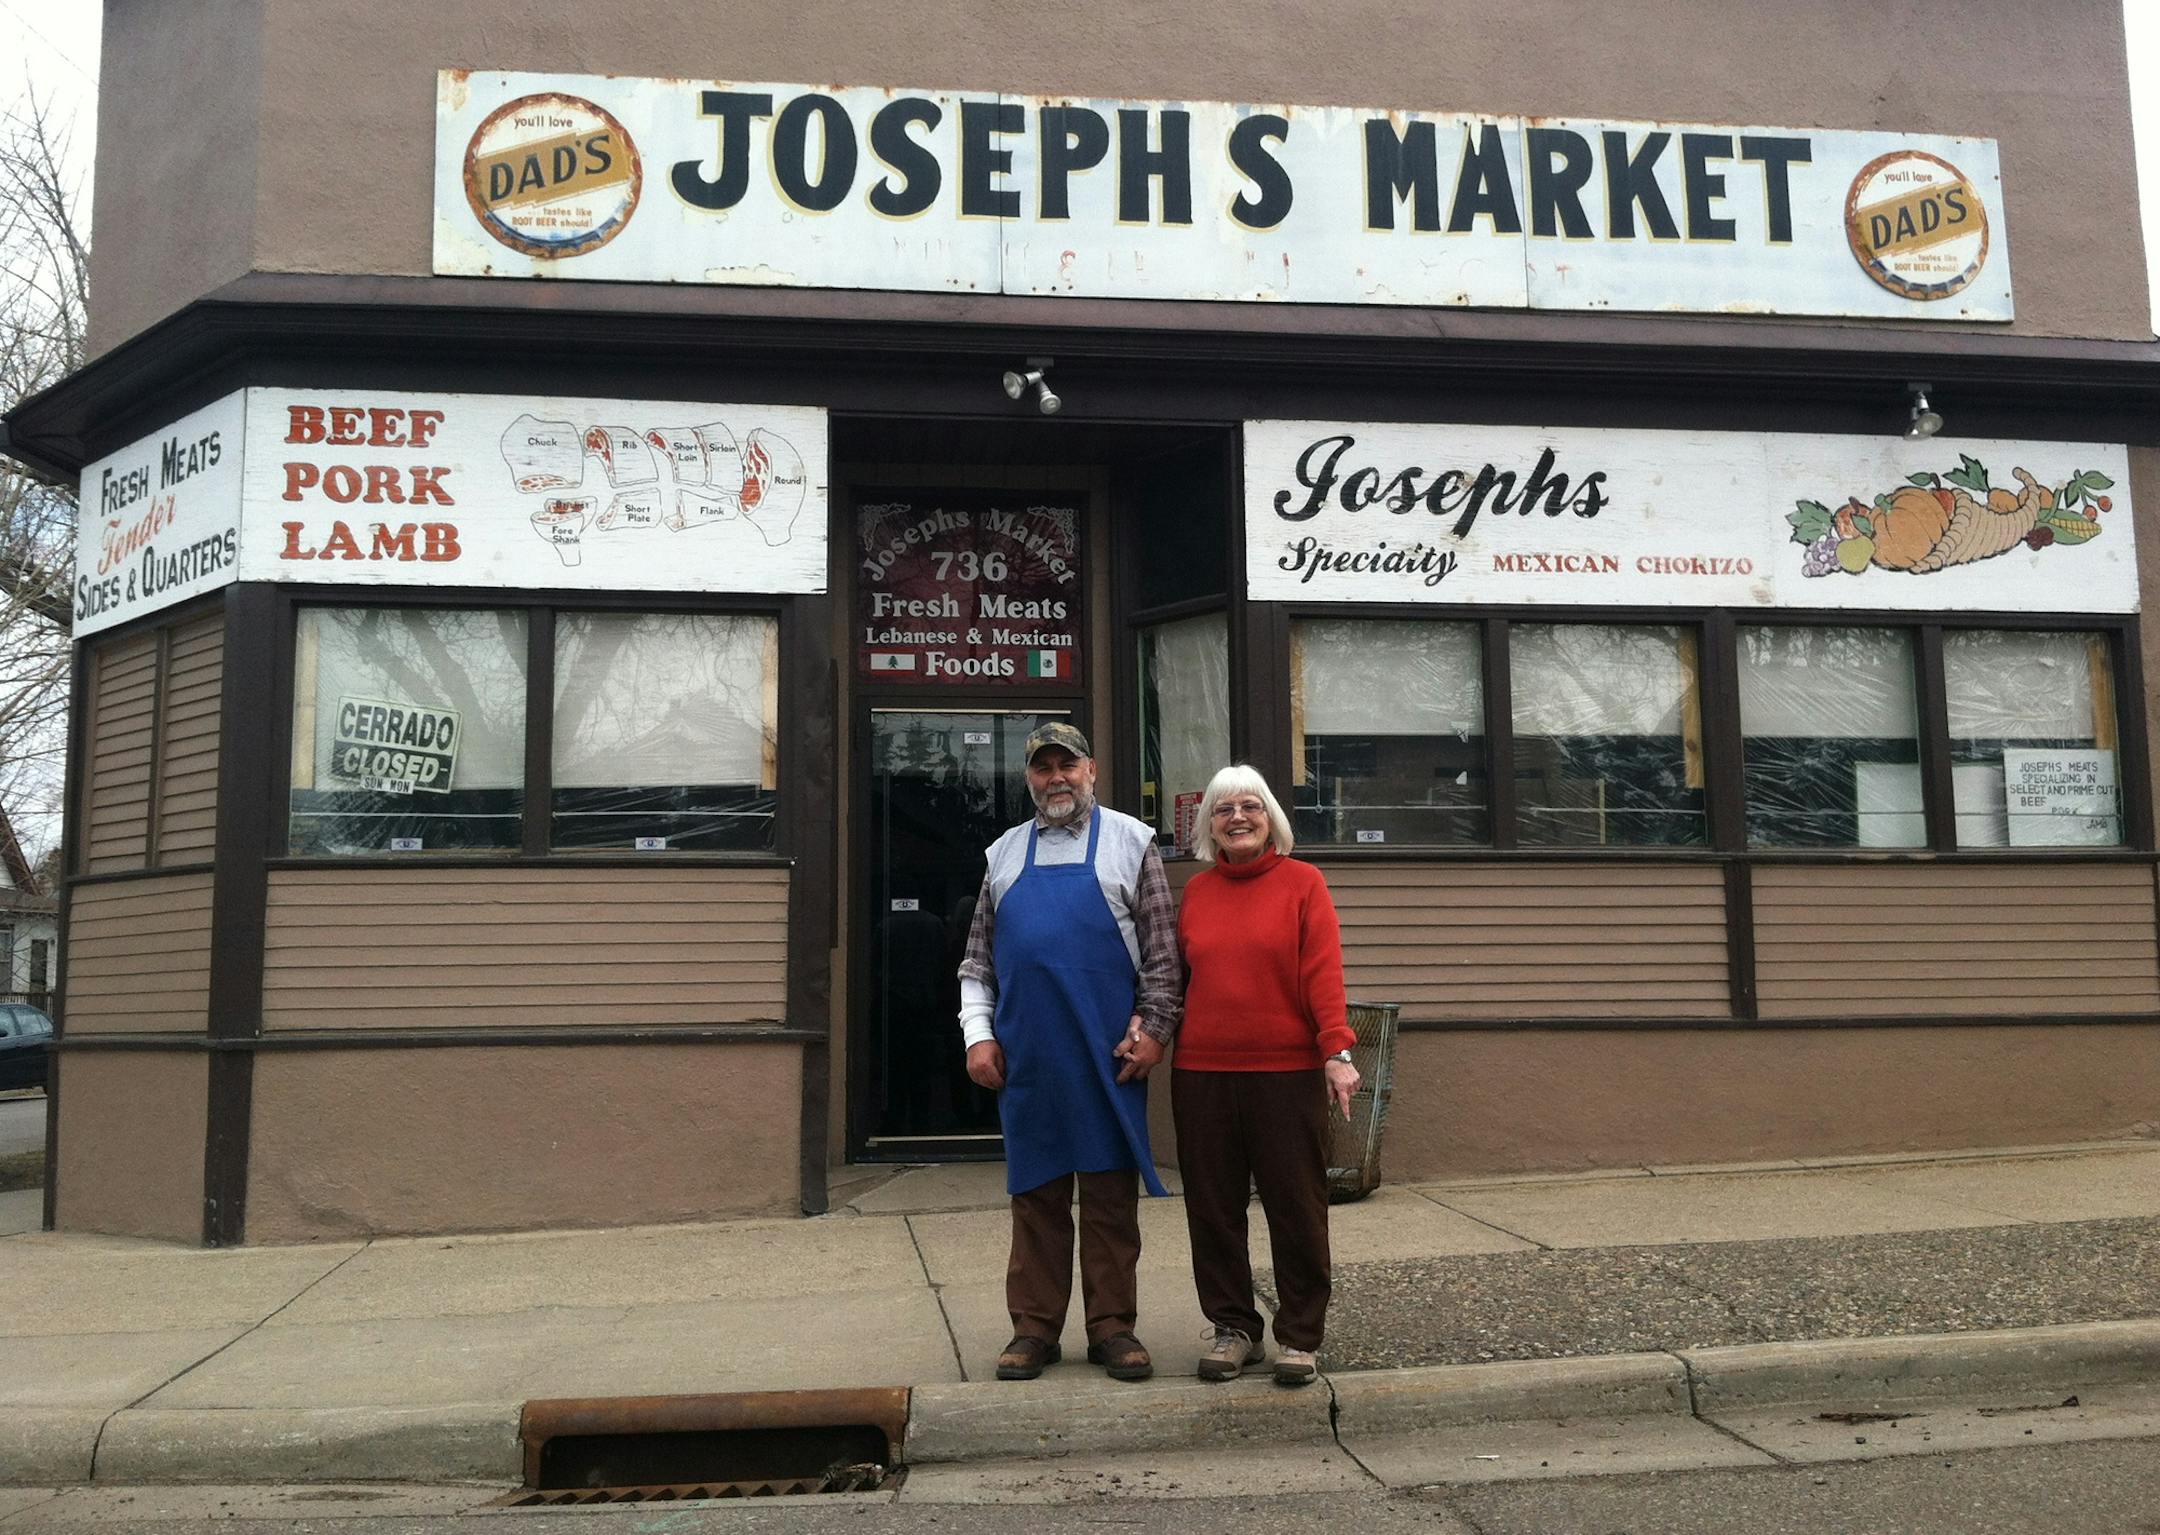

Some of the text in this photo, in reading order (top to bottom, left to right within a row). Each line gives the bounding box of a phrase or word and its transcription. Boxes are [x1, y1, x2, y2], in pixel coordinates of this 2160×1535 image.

[514, 115, 574, 129] you'll love
[489, 134, 612, 201] DAD'S
[1361, 118, 1812, 243] MARKET
[1884, 171, 1910, 184] you'll
[536, 217, 557, 226] BEER
[1870, 187, 1967, 250] DAD'S
[284, 405, 445, 448] BEEF
[528, 437, 558, 447] Chuck
[622, 441, 638, 450] Rib
[673, 442, 699, 452] Short
[709, 443, 736, 453] Sirloin
[678, 452, 698, 463] Loin
[101, 430, 222, 517] FRESH MEATS
[774, 475, 802, 486] Round
[281, 462, 456, 505] PORK
[1273, 435, 1610, 540] Josephs
[624, 504, 650, 513] Short
[700, 505, 725, 516] Flank
[627, 513, 651, 523] Plate
[97, 493, 176, 576] Tender
[552, 526, 573, 535] Fore
[279, 520, 462, 562] LAMB
[553, 535, 580, 545] Shank
[863, 507, 1076, 584] Josephs Market
[931, 550, 1009, 581] 736
[1492, 555, 1619, 573] MEXICAN
[1636, 557, 1753, 575] CHORIZO
[76, 526, 237, 622] SIDES & QUARTERS
[872, 592, 1067, 619] Fresh Meats
[865, 627, 1072, 646] Lebanese & Mexican
[925, 651, 1015, 676] Foods
[340, 702, 454, 750] CERRADO
[2019, 761, 2098, 773] JOSEPHS MEATS
[364, 776, 410, 793] SUN MON
[2086, 774, 2096, 784] IN
[2010, 783, 2115, 796] SELECT AND PRIME CUT
[2020, 795, 2047, 807] BEEF
